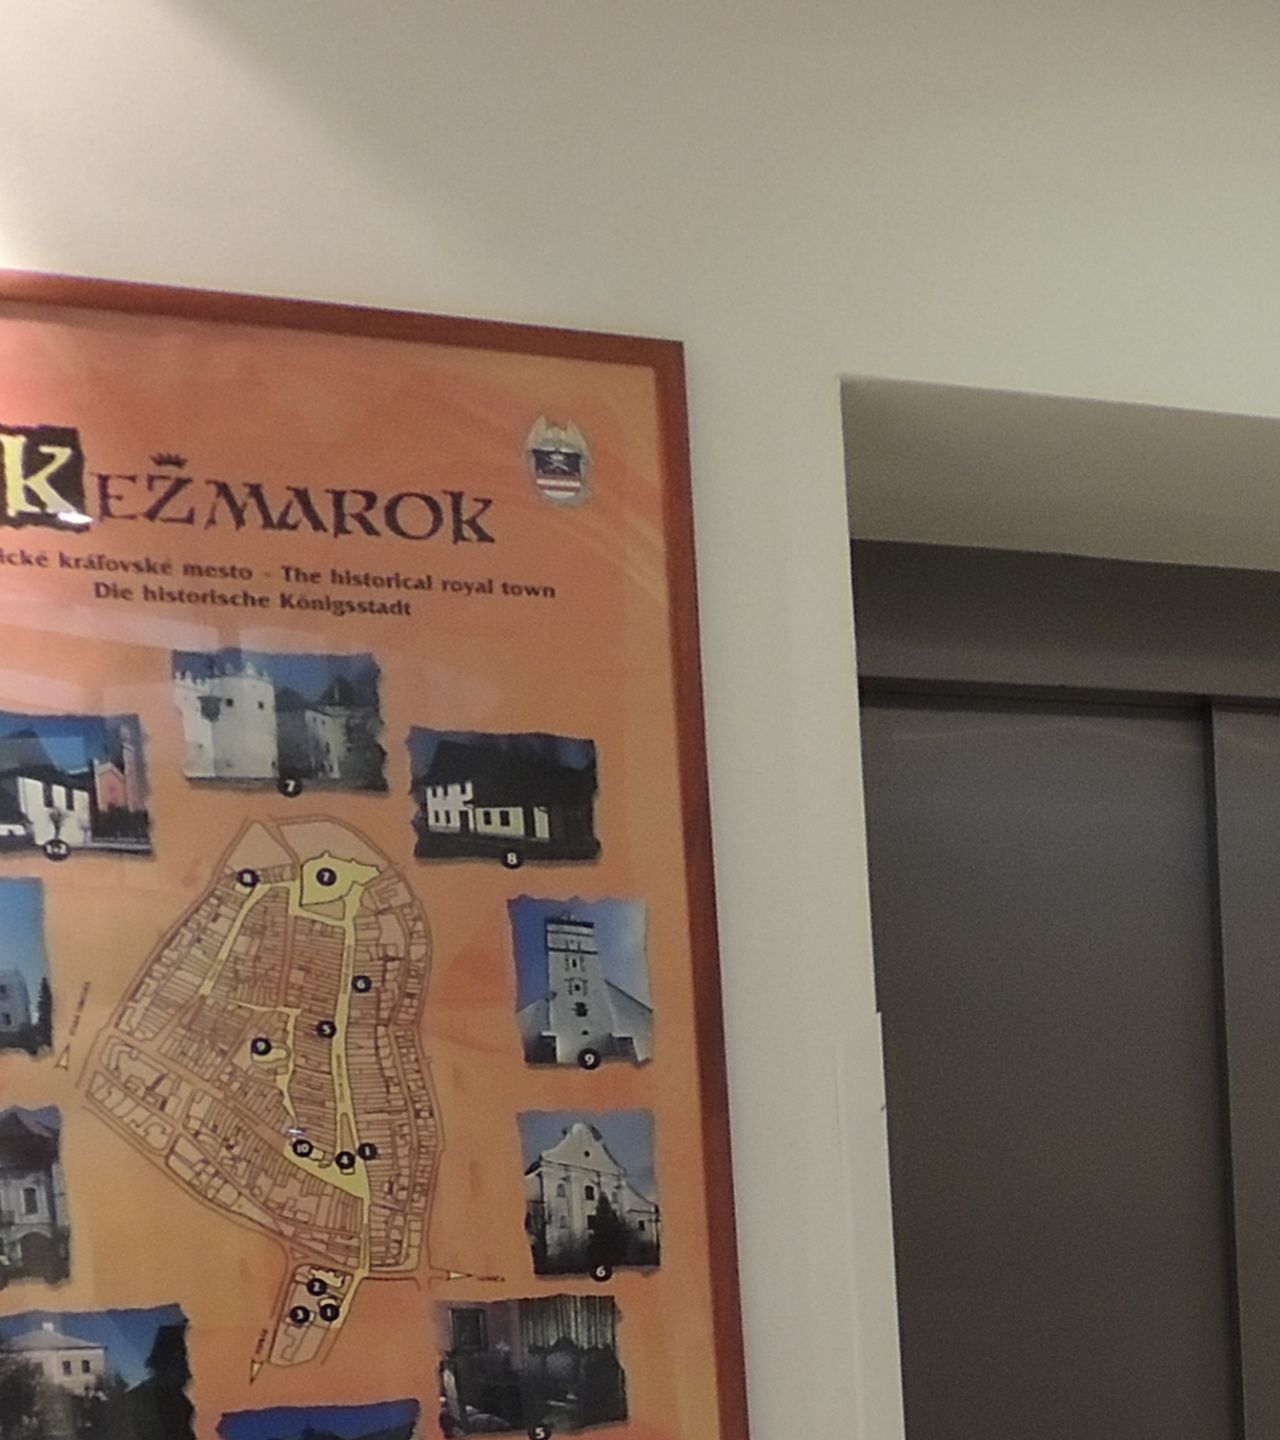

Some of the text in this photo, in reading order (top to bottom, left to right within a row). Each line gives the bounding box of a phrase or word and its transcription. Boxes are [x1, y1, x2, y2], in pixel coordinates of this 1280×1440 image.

[182, 562, 254, 581] mesto
[281, 565, 322, 584] The
[330, 569, 432, 592] historical
[441, 579, 494, 599] royal
[501, 581, 557, 600] town
[94, 582, 412, 618] Die historische Königsstadt
[284, 779, 296, 792] 7
[506, 852, 518, 865] 8
[320, 871, 331, 882] 7
[356, 979, 365, 990] 6
[584, 1053, 595, 1066] 9
[339, 1155, 349, 1165] 4
[595, 1265, 606, 1278] 6
[312, 1281, 320, 1292] 2
[295, 1309, 304, 1320] 3
[534, 1427, 545, 1440] 5
